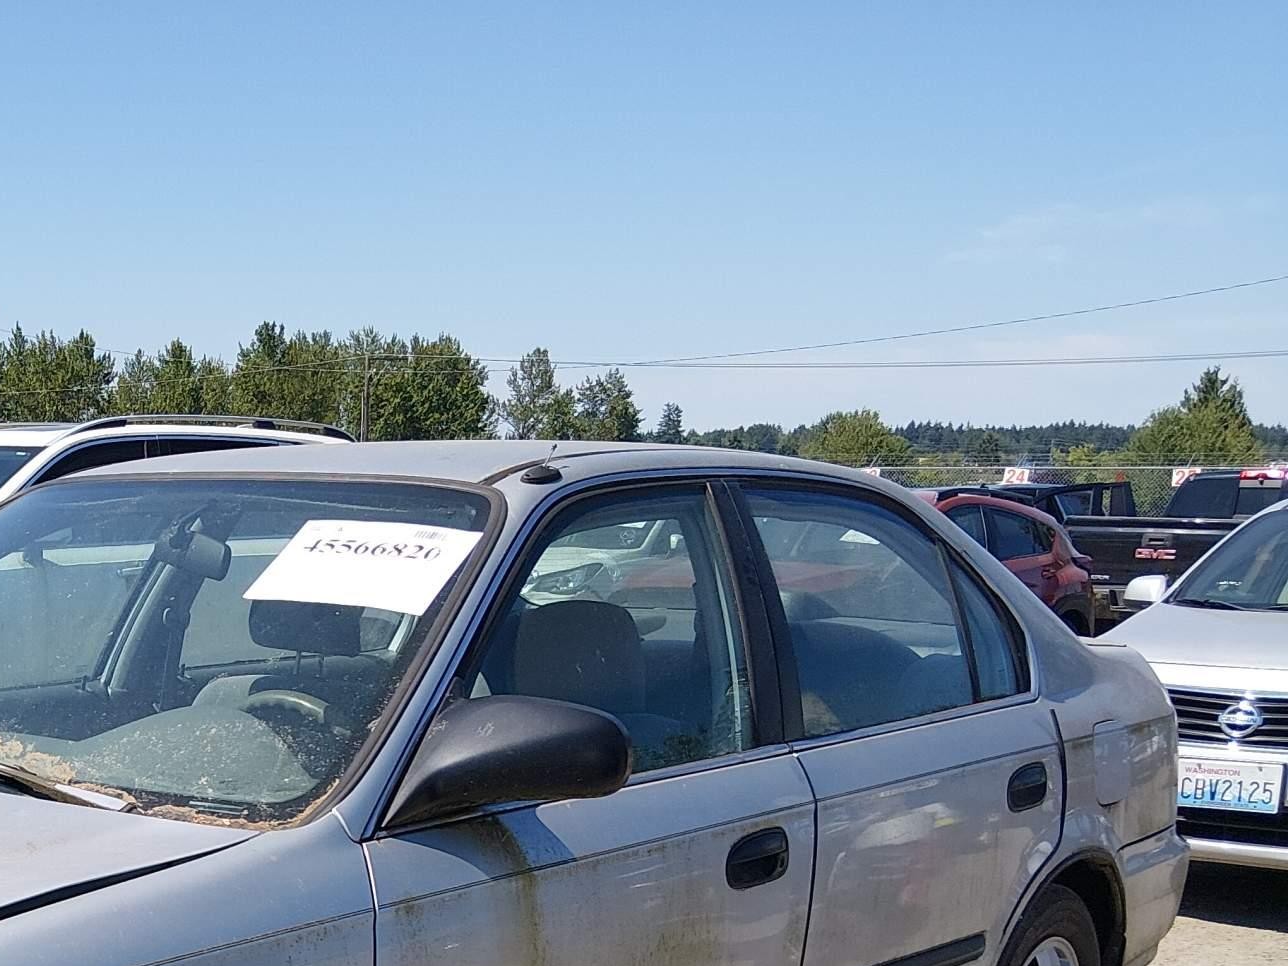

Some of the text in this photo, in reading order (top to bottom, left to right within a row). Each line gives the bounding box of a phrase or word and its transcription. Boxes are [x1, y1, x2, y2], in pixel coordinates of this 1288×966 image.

[1005, 469, 1025, 484] 24
[303, 538, 442, 560] 45566820
[1135, 548, 1177, 560] GMC
[1185, 766, 1241, 777] WASHINGTON
[1180, 777, 1276, 805] CBV2125
